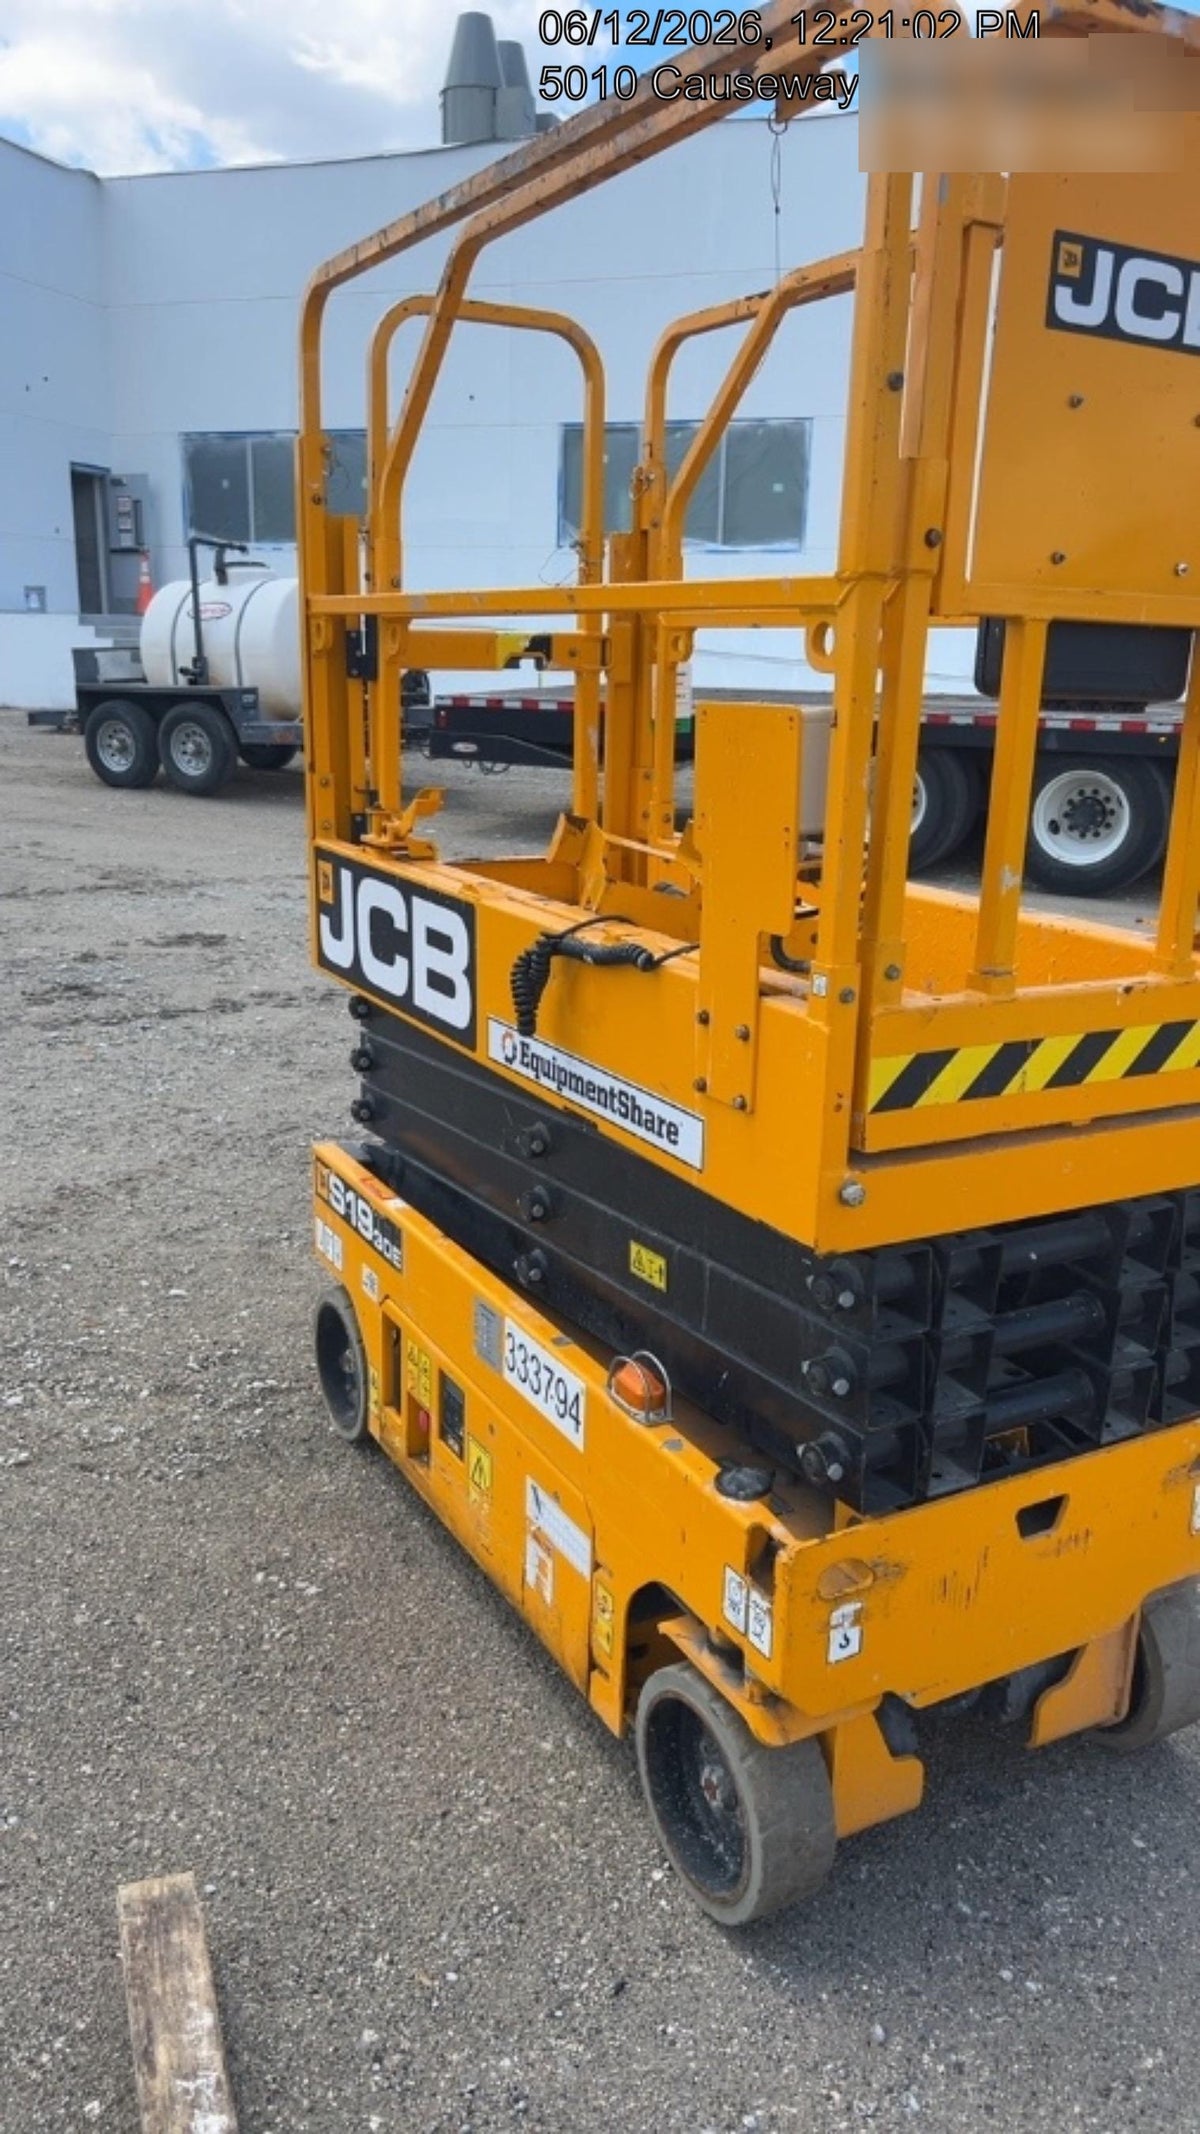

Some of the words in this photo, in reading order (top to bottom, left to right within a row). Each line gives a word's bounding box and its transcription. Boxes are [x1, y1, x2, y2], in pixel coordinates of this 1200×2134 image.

[1055, 249, 1200, 347] JC
[320, 867, 472, 1030] JCB
[519, 1041, 679, 1146] EquipmentShare
